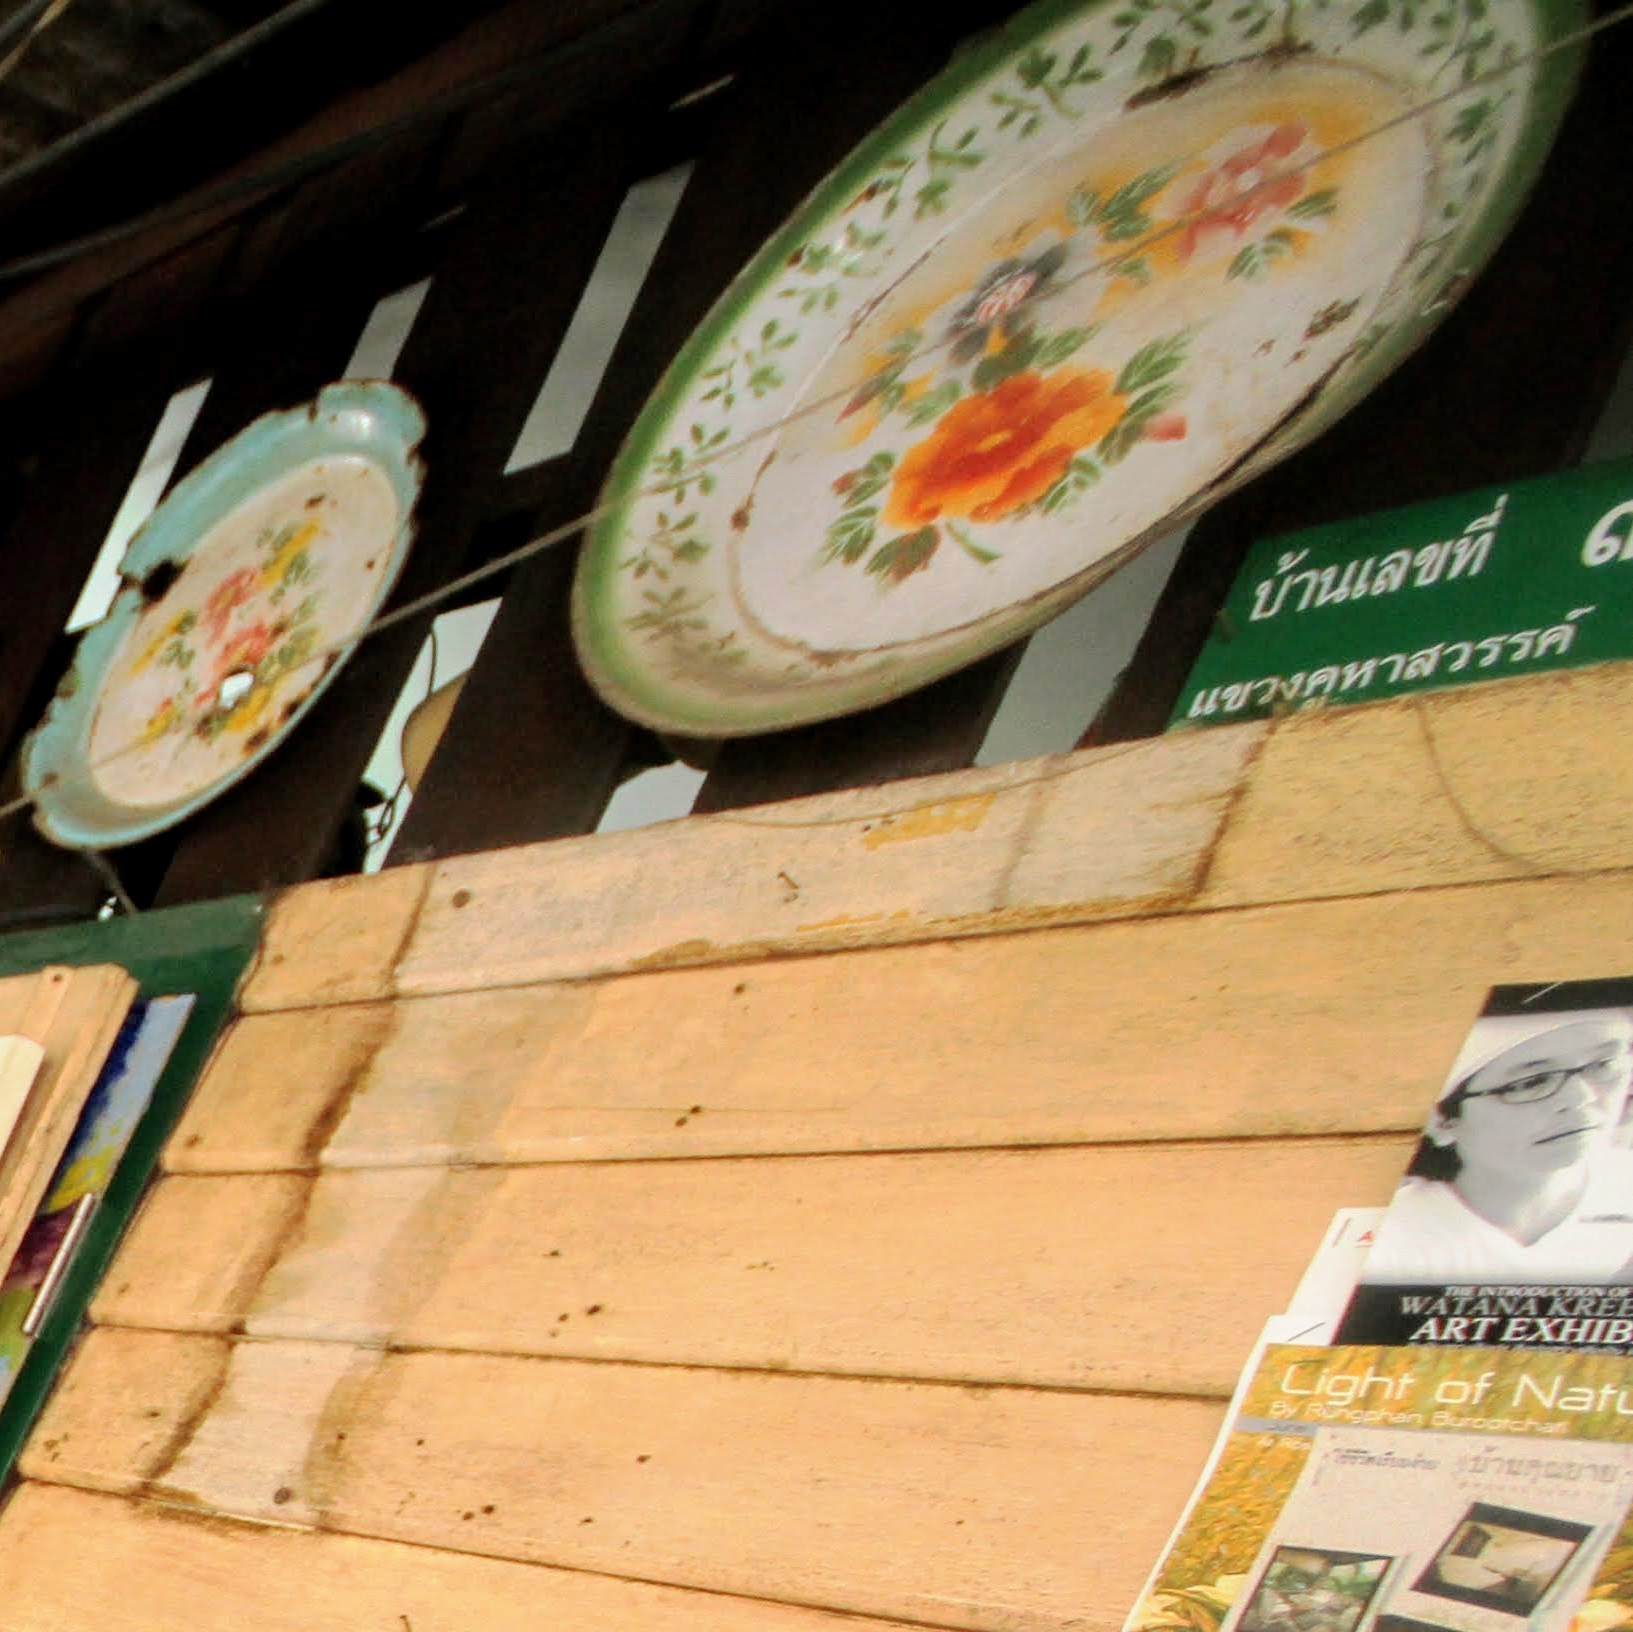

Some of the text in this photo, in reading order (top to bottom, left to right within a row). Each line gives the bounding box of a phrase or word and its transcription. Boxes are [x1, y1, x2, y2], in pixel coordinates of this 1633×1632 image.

[1249, 493, 1509, 622] บ้านเลขที่
[1400, 1295, 1539, 1316] WATANA
[1409, 1316, 1500, 1342] ART
[1281, 1364, 1416, 1406] Light
[1435, 1371, 1496, 1405] of
